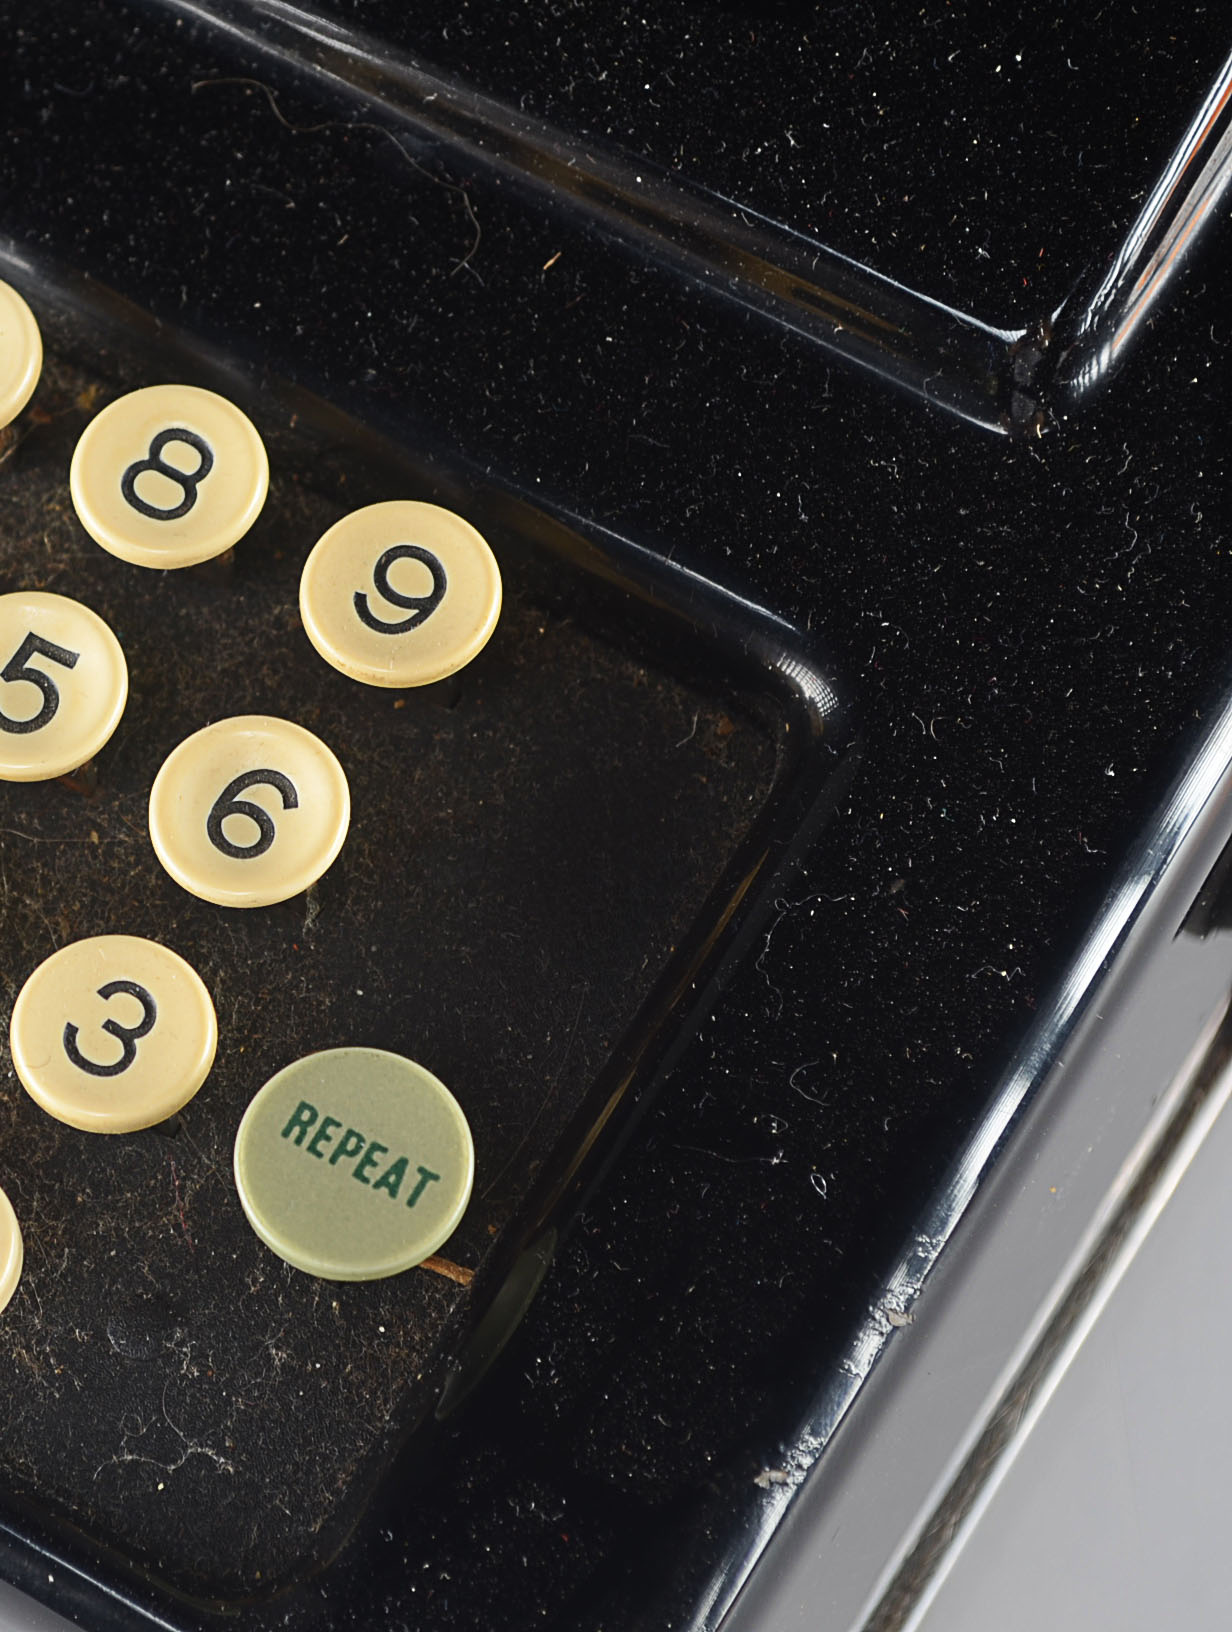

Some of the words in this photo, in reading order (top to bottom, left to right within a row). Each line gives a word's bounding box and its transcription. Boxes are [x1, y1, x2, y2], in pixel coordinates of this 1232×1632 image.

[120, 427, 214, 522] 8
[353, 544, 448, 635] 9
[206, 768, 299, 860] 6
[63, 980, 157, 1078] 3
[280, 1099, 441, 1209] REPEAT
